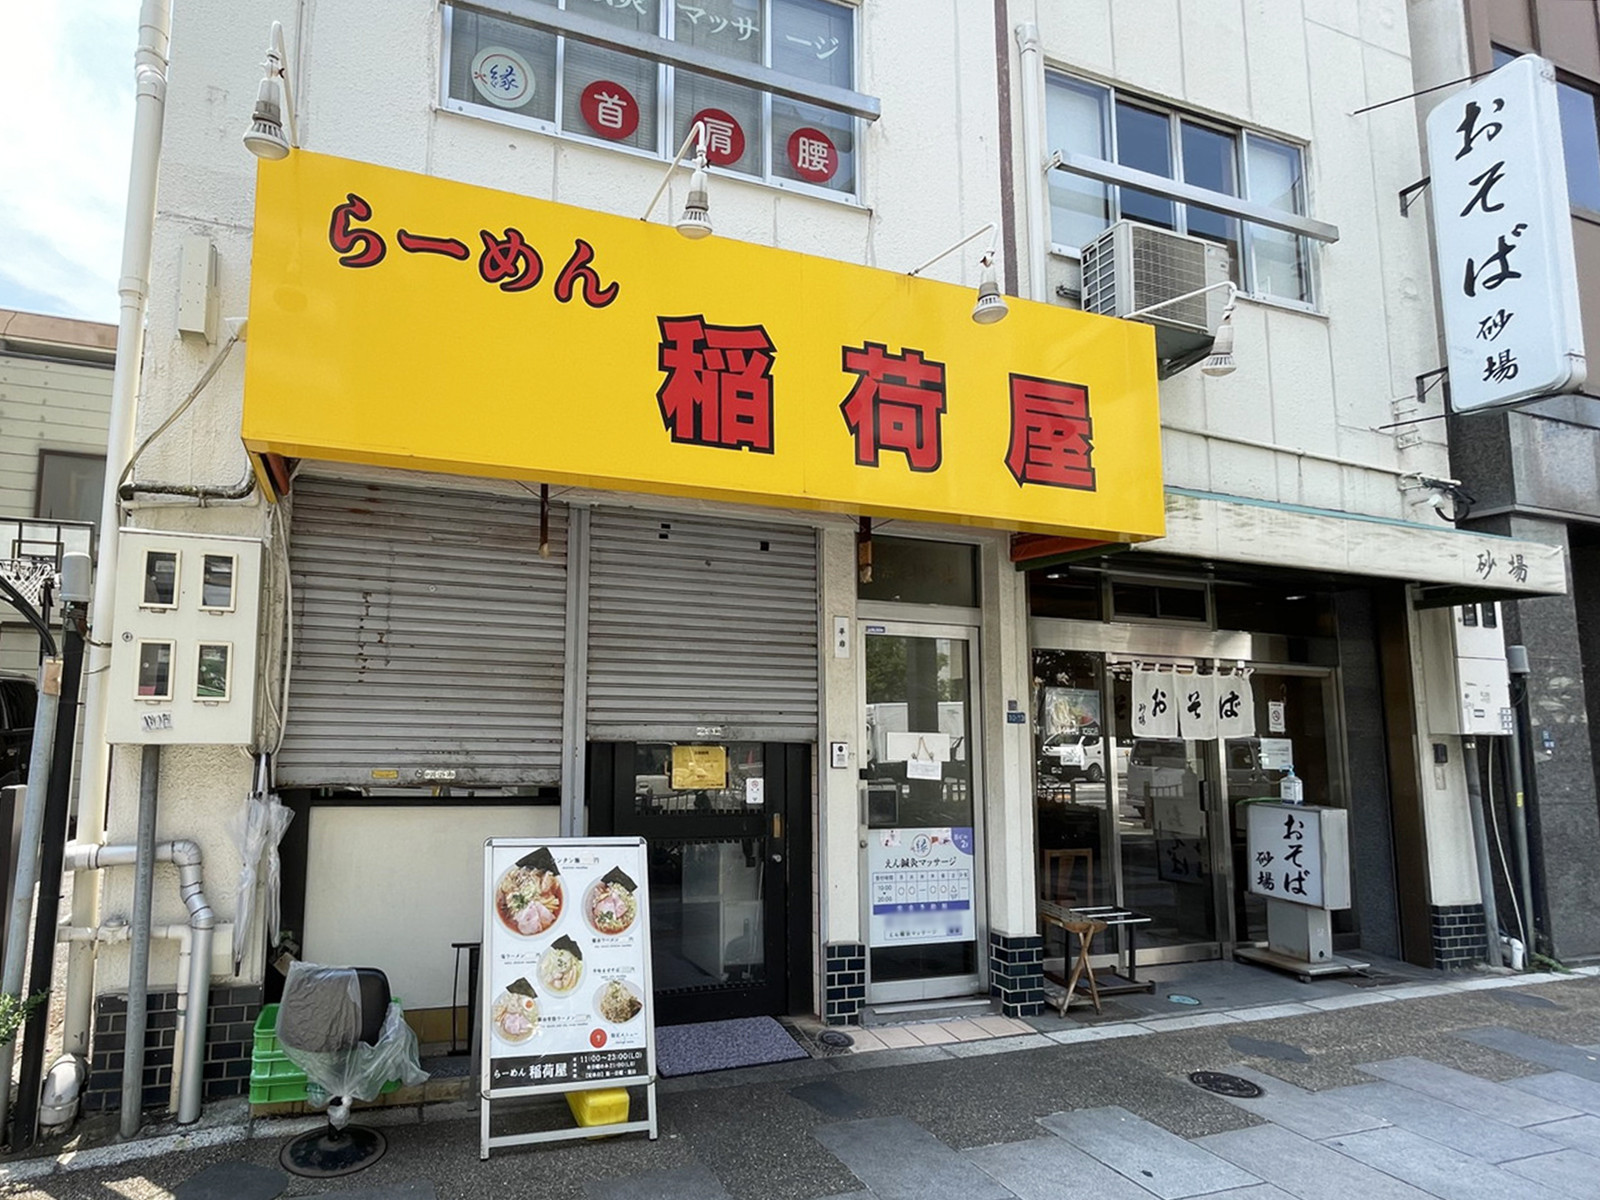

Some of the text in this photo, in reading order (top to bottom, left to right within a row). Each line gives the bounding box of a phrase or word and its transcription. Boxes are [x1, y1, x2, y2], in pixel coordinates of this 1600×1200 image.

[594, 92, 626, 129] 首
[703, 116, 734, 156] 肩
[797, 137, 829, 174] 腰
[329, 192, 621, 310] らーめん
[1454, 98, 1528, 384] おそば 砂場
[655, 313, 1098, 492] 稲荷屋
[1476, 550, 1529, 583] 砂場
[1151, 687, 1242, 719] おそば
[1256, 851, 1275, 892] 砂場
[1283, 814, 1311, 897] おそば
[493, 1062, 568, 1080] らーめん 稲荷屋
